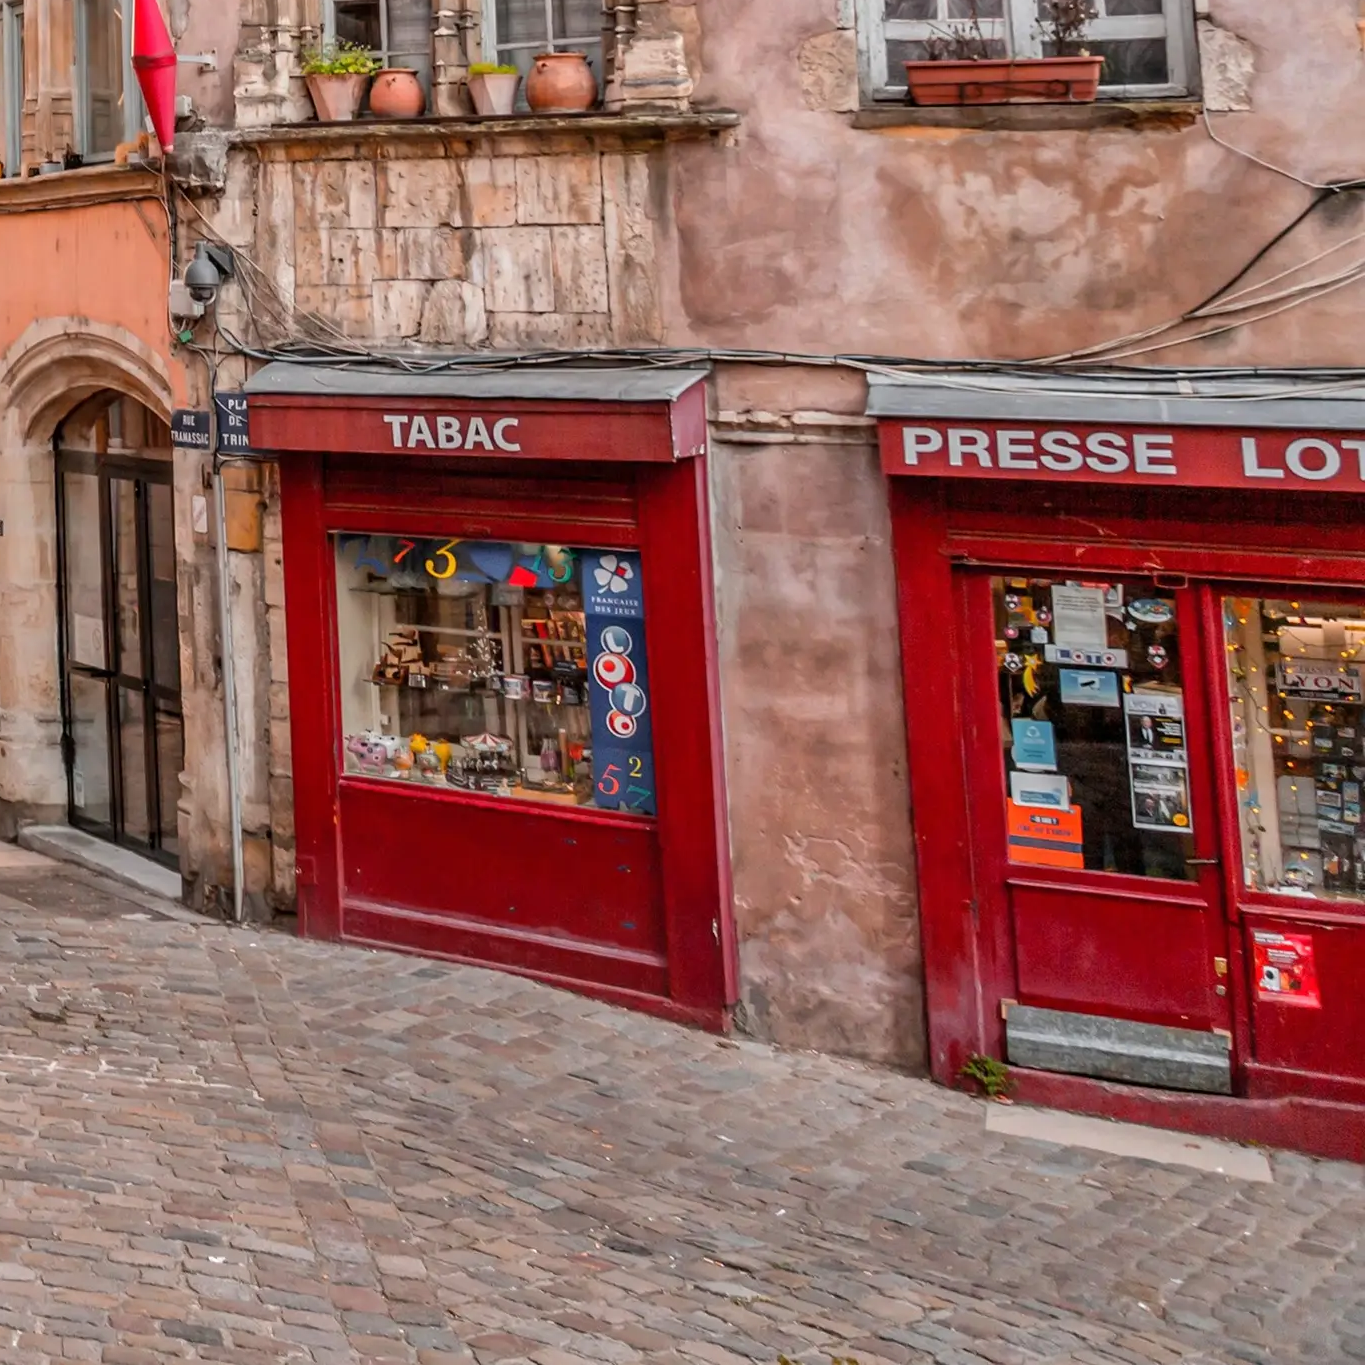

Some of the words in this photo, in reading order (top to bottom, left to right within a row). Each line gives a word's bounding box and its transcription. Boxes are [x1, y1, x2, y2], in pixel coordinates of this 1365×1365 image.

[182, 414, 196, 427] RUE
[228, 415, 243, 427] DE
[170, 429, 210, 446] TRAMASSAC
[383, 414, 522, 453] TABAC
[901, 426, 1177, 476] PRESSE
[1241, 437, 1365, 481] LOT
[595, 606, 610, 614] DES
[614, 607, 637, 616] JEUX
[1282, 674, 1354, 690] LYON
[629, 756, 641, 778] 2
[599, 764, 621, 795] 5
